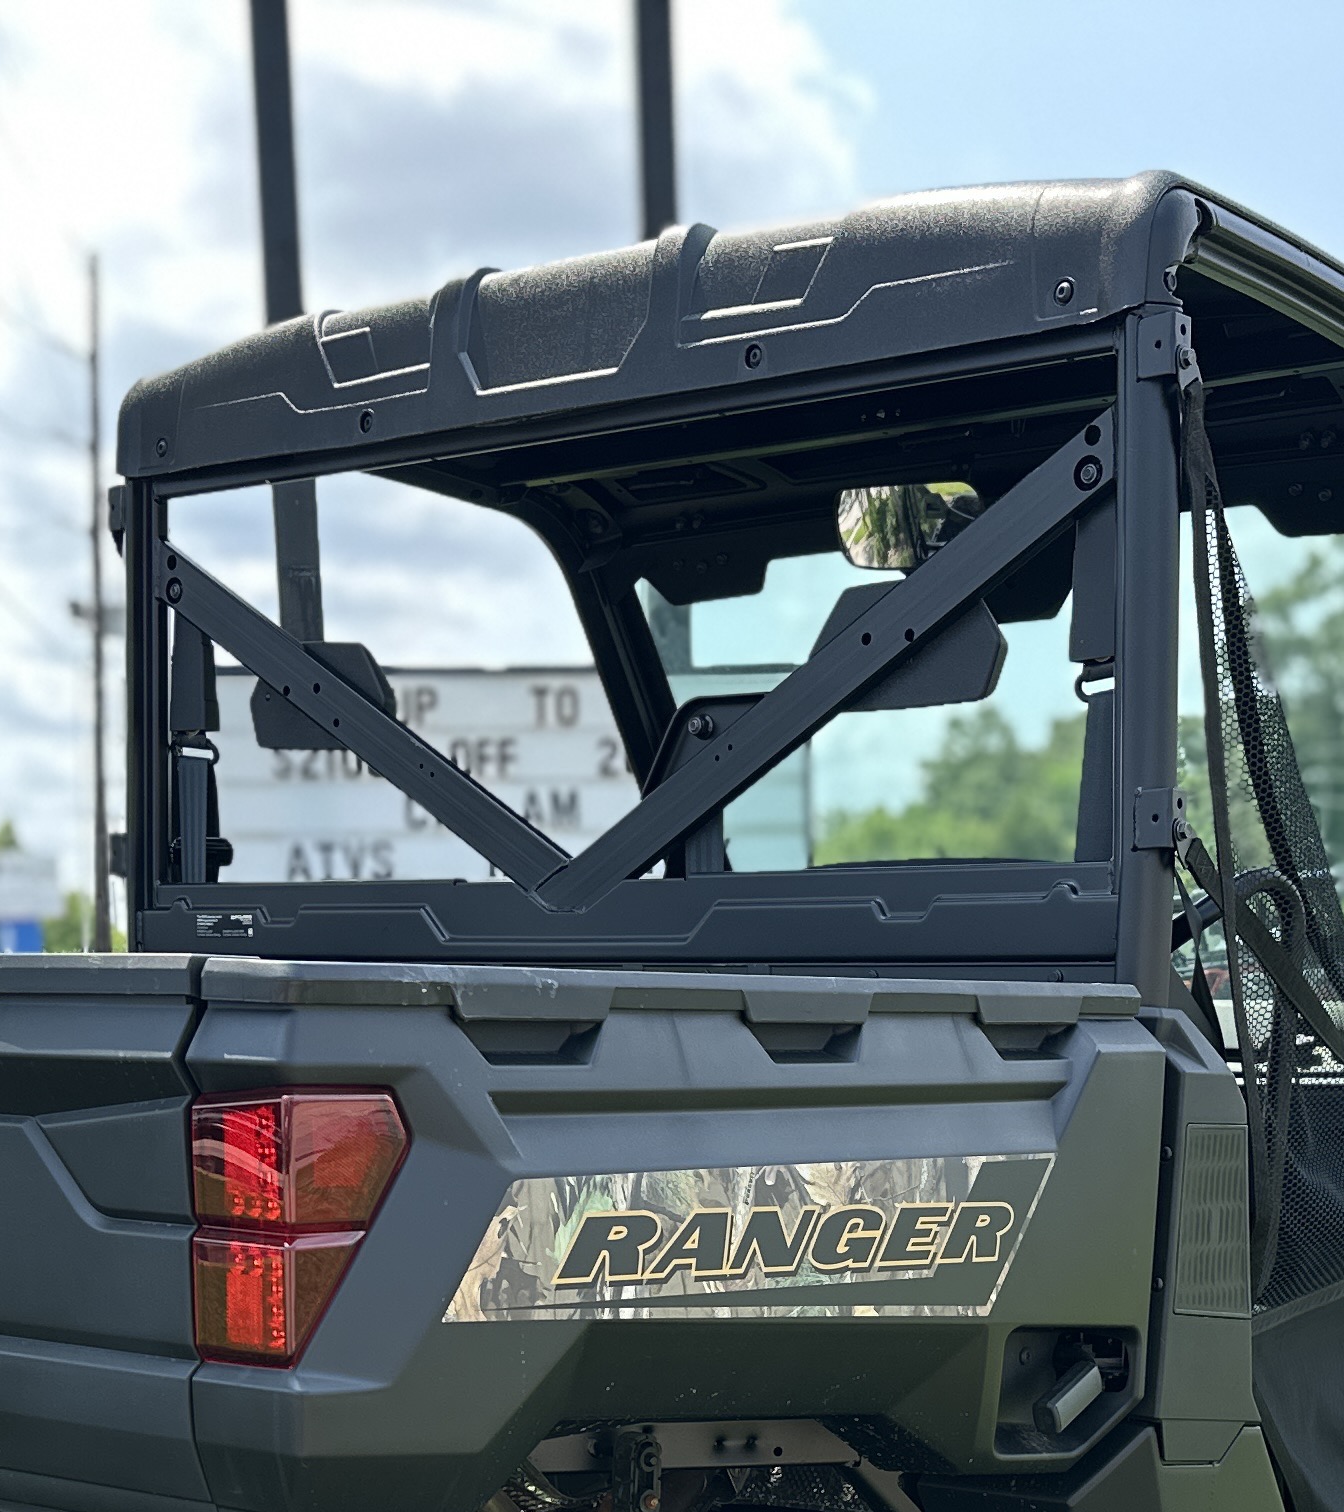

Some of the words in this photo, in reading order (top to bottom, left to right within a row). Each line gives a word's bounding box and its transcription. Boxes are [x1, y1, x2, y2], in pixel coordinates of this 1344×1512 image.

[528, 684, 581, 727] TO
[448, 735, 519, 777] OFF
[287, 837, 394, 880] ATVS
[552, 1201, 1014, 1288] RANGER
